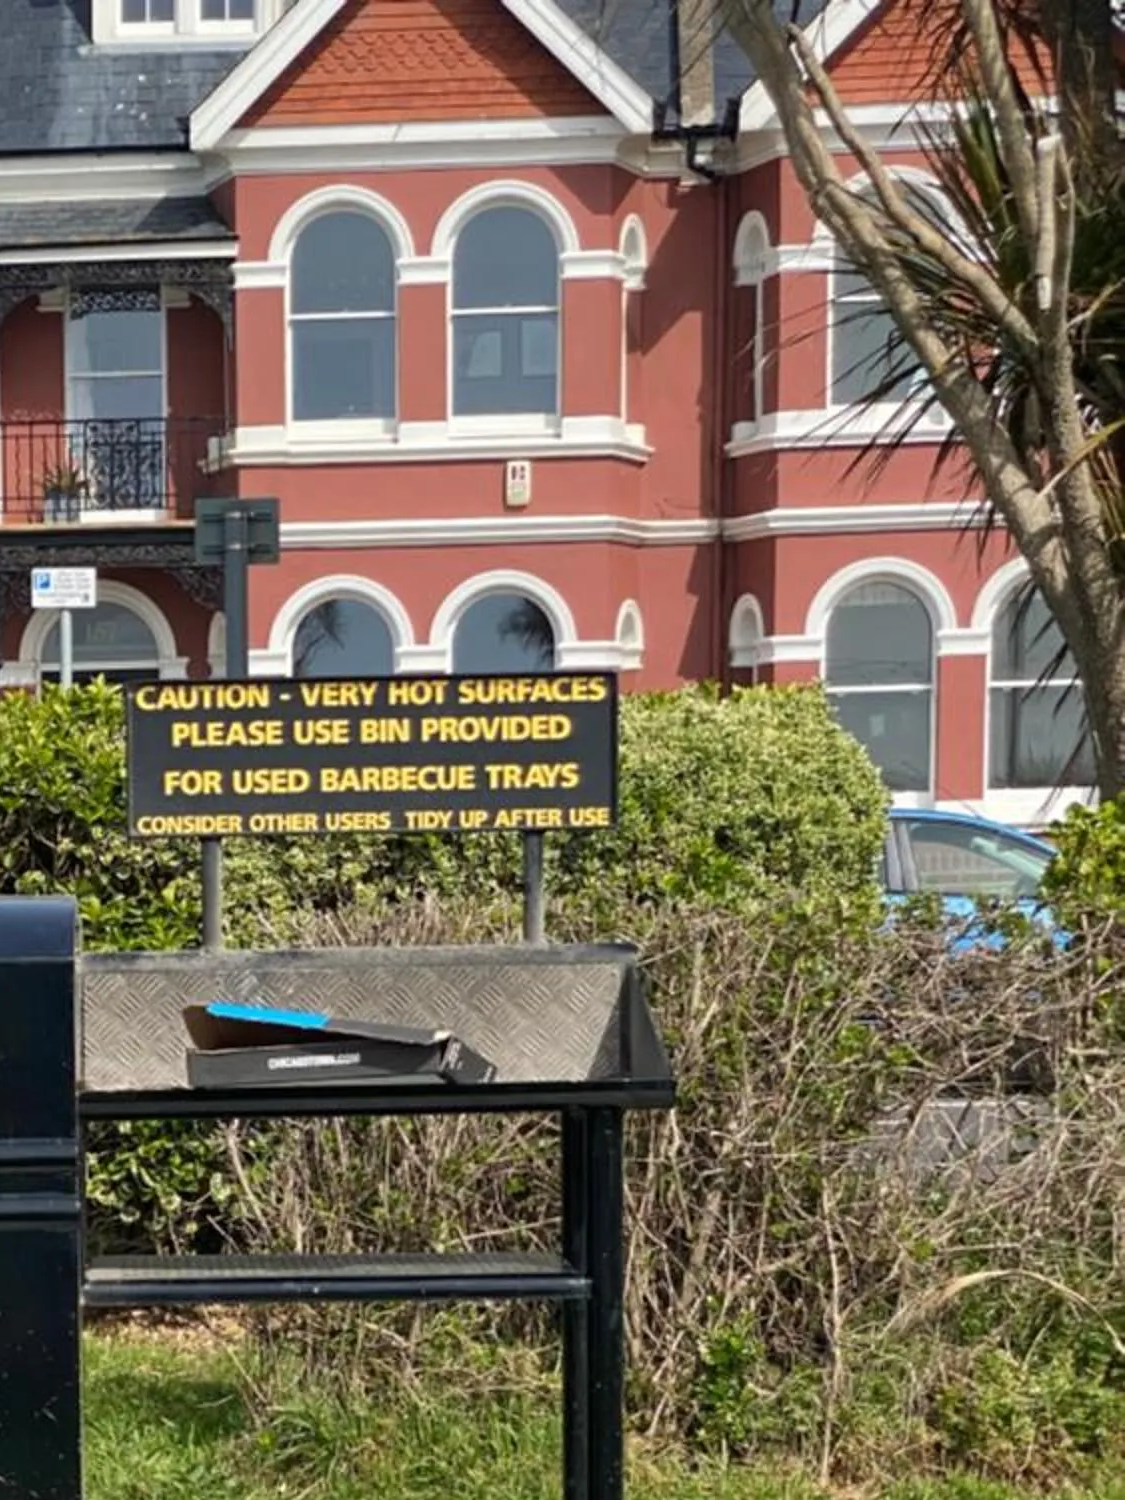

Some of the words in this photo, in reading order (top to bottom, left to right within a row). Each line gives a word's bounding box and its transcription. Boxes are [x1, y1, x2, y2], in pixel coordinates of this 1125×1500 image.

[136, 685, 269, 710] CAUTION
[301, 683, 377, 706] VERY
[389, 681, 448, 705] HOT
[459, 678, 607, 704] SURFACES
[172, 720, 283, 746] PLEASE
[294, 719, 350, 744] USE
[360, 718, 410, 743] BIN
[421, 715, 571, 742] PROVIDED
[164, 770, 222, 795] FOR
[233, 769, 310, 794] USED
[321, 765, 475, 792] BARBECUE
[485, 763, 579, 789] TRAYS
[137, 815, 243, 834] CONSIDER
[249, 813, 318, 832] OTHER
[325, 812, 391, 831] USERS
[405, 810, 453, 830] TIDY
[459, 810, 489, 829] UP
[494, 808, 563, 828] AFTER
[569, 807, 610, 826] USE
